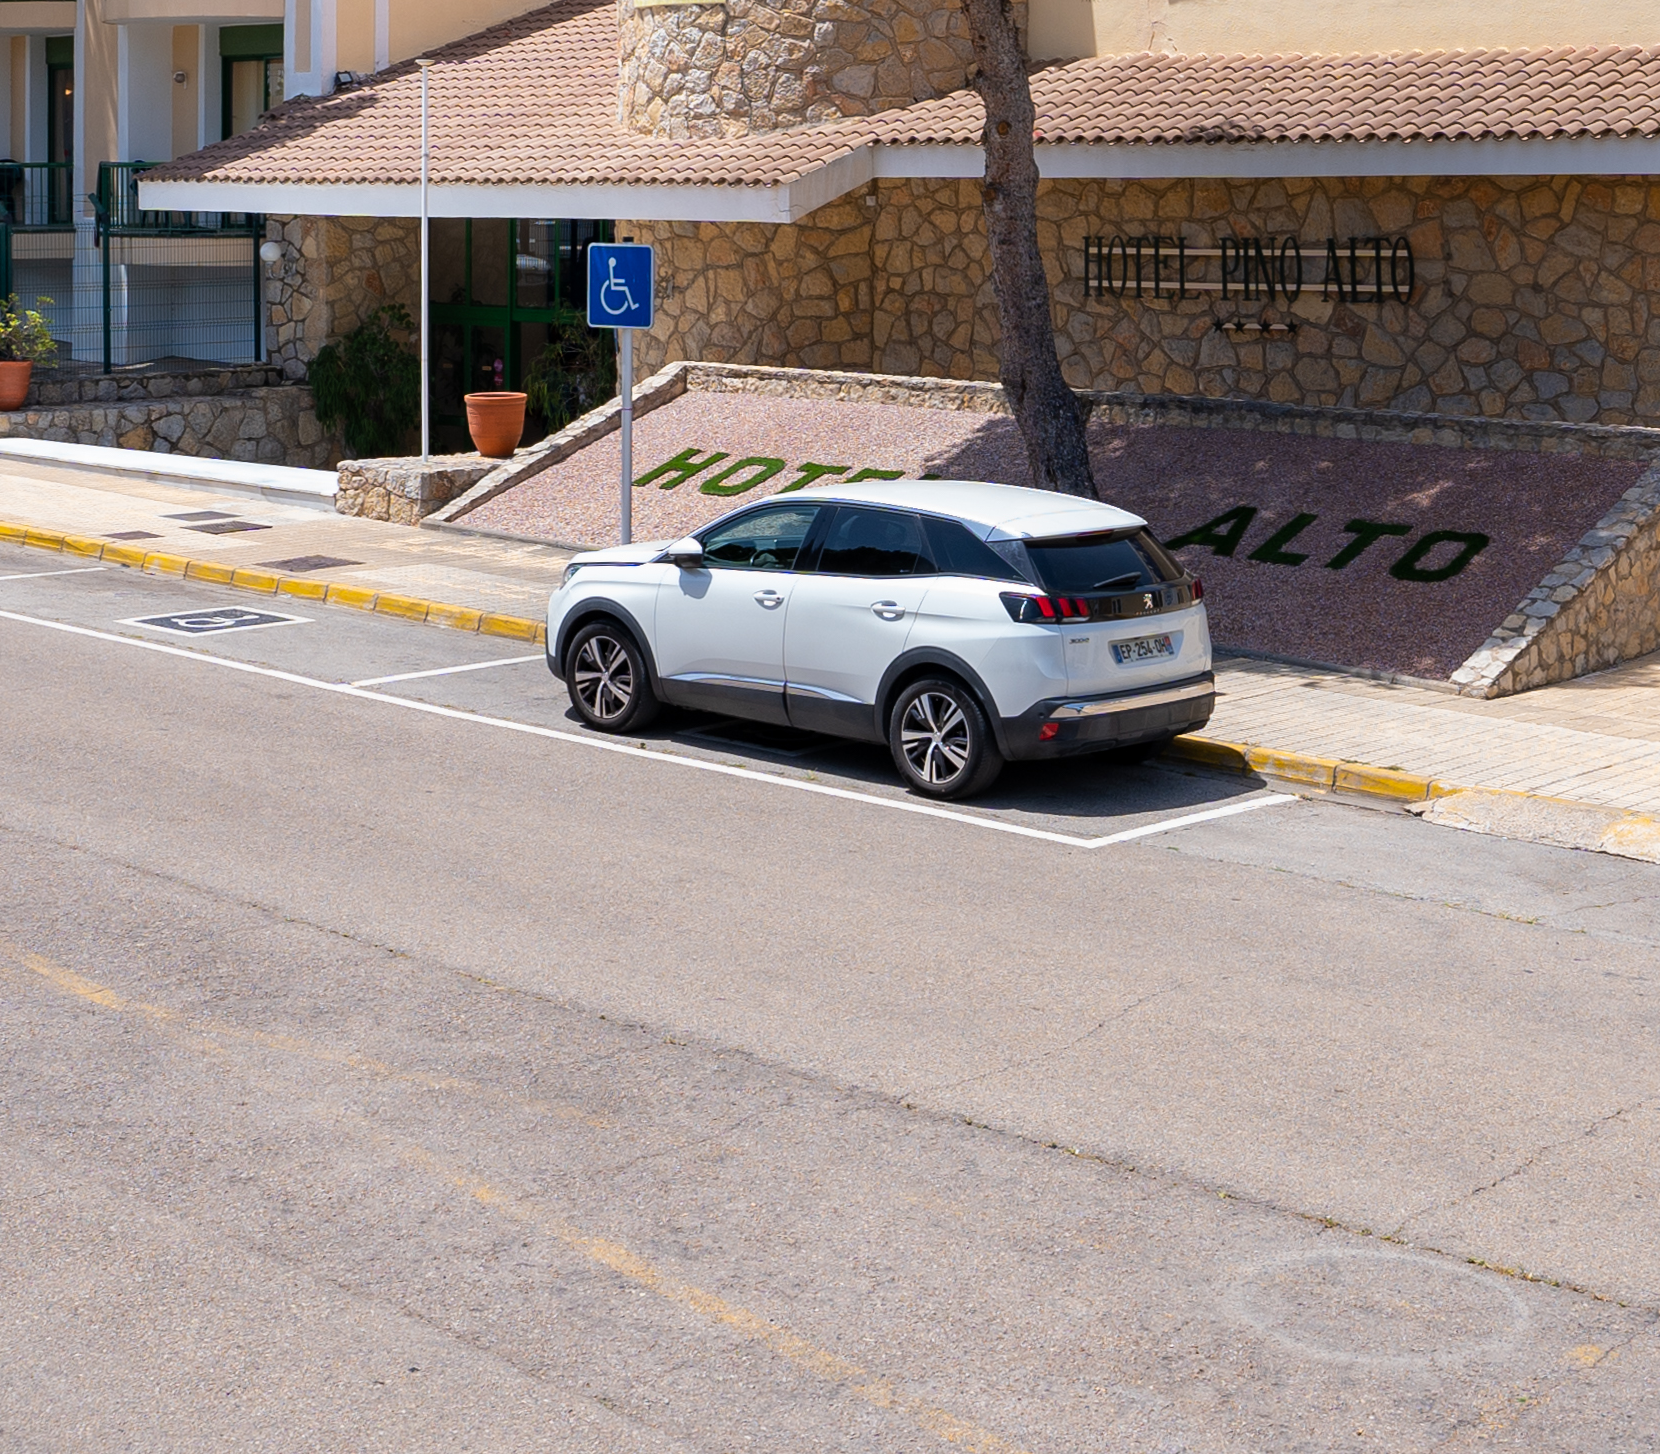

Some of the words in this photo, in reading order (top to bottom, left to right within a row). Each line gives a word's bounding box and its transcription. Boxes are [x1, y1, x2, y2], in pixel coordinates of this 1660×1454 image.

[1082, 234, 1201, 300] HOTEL
[1219, 236, 1302, 303] PINO
[1321, 236, 1415, 305] ALTO
[1163, 506, 1489, 583] ALTO
